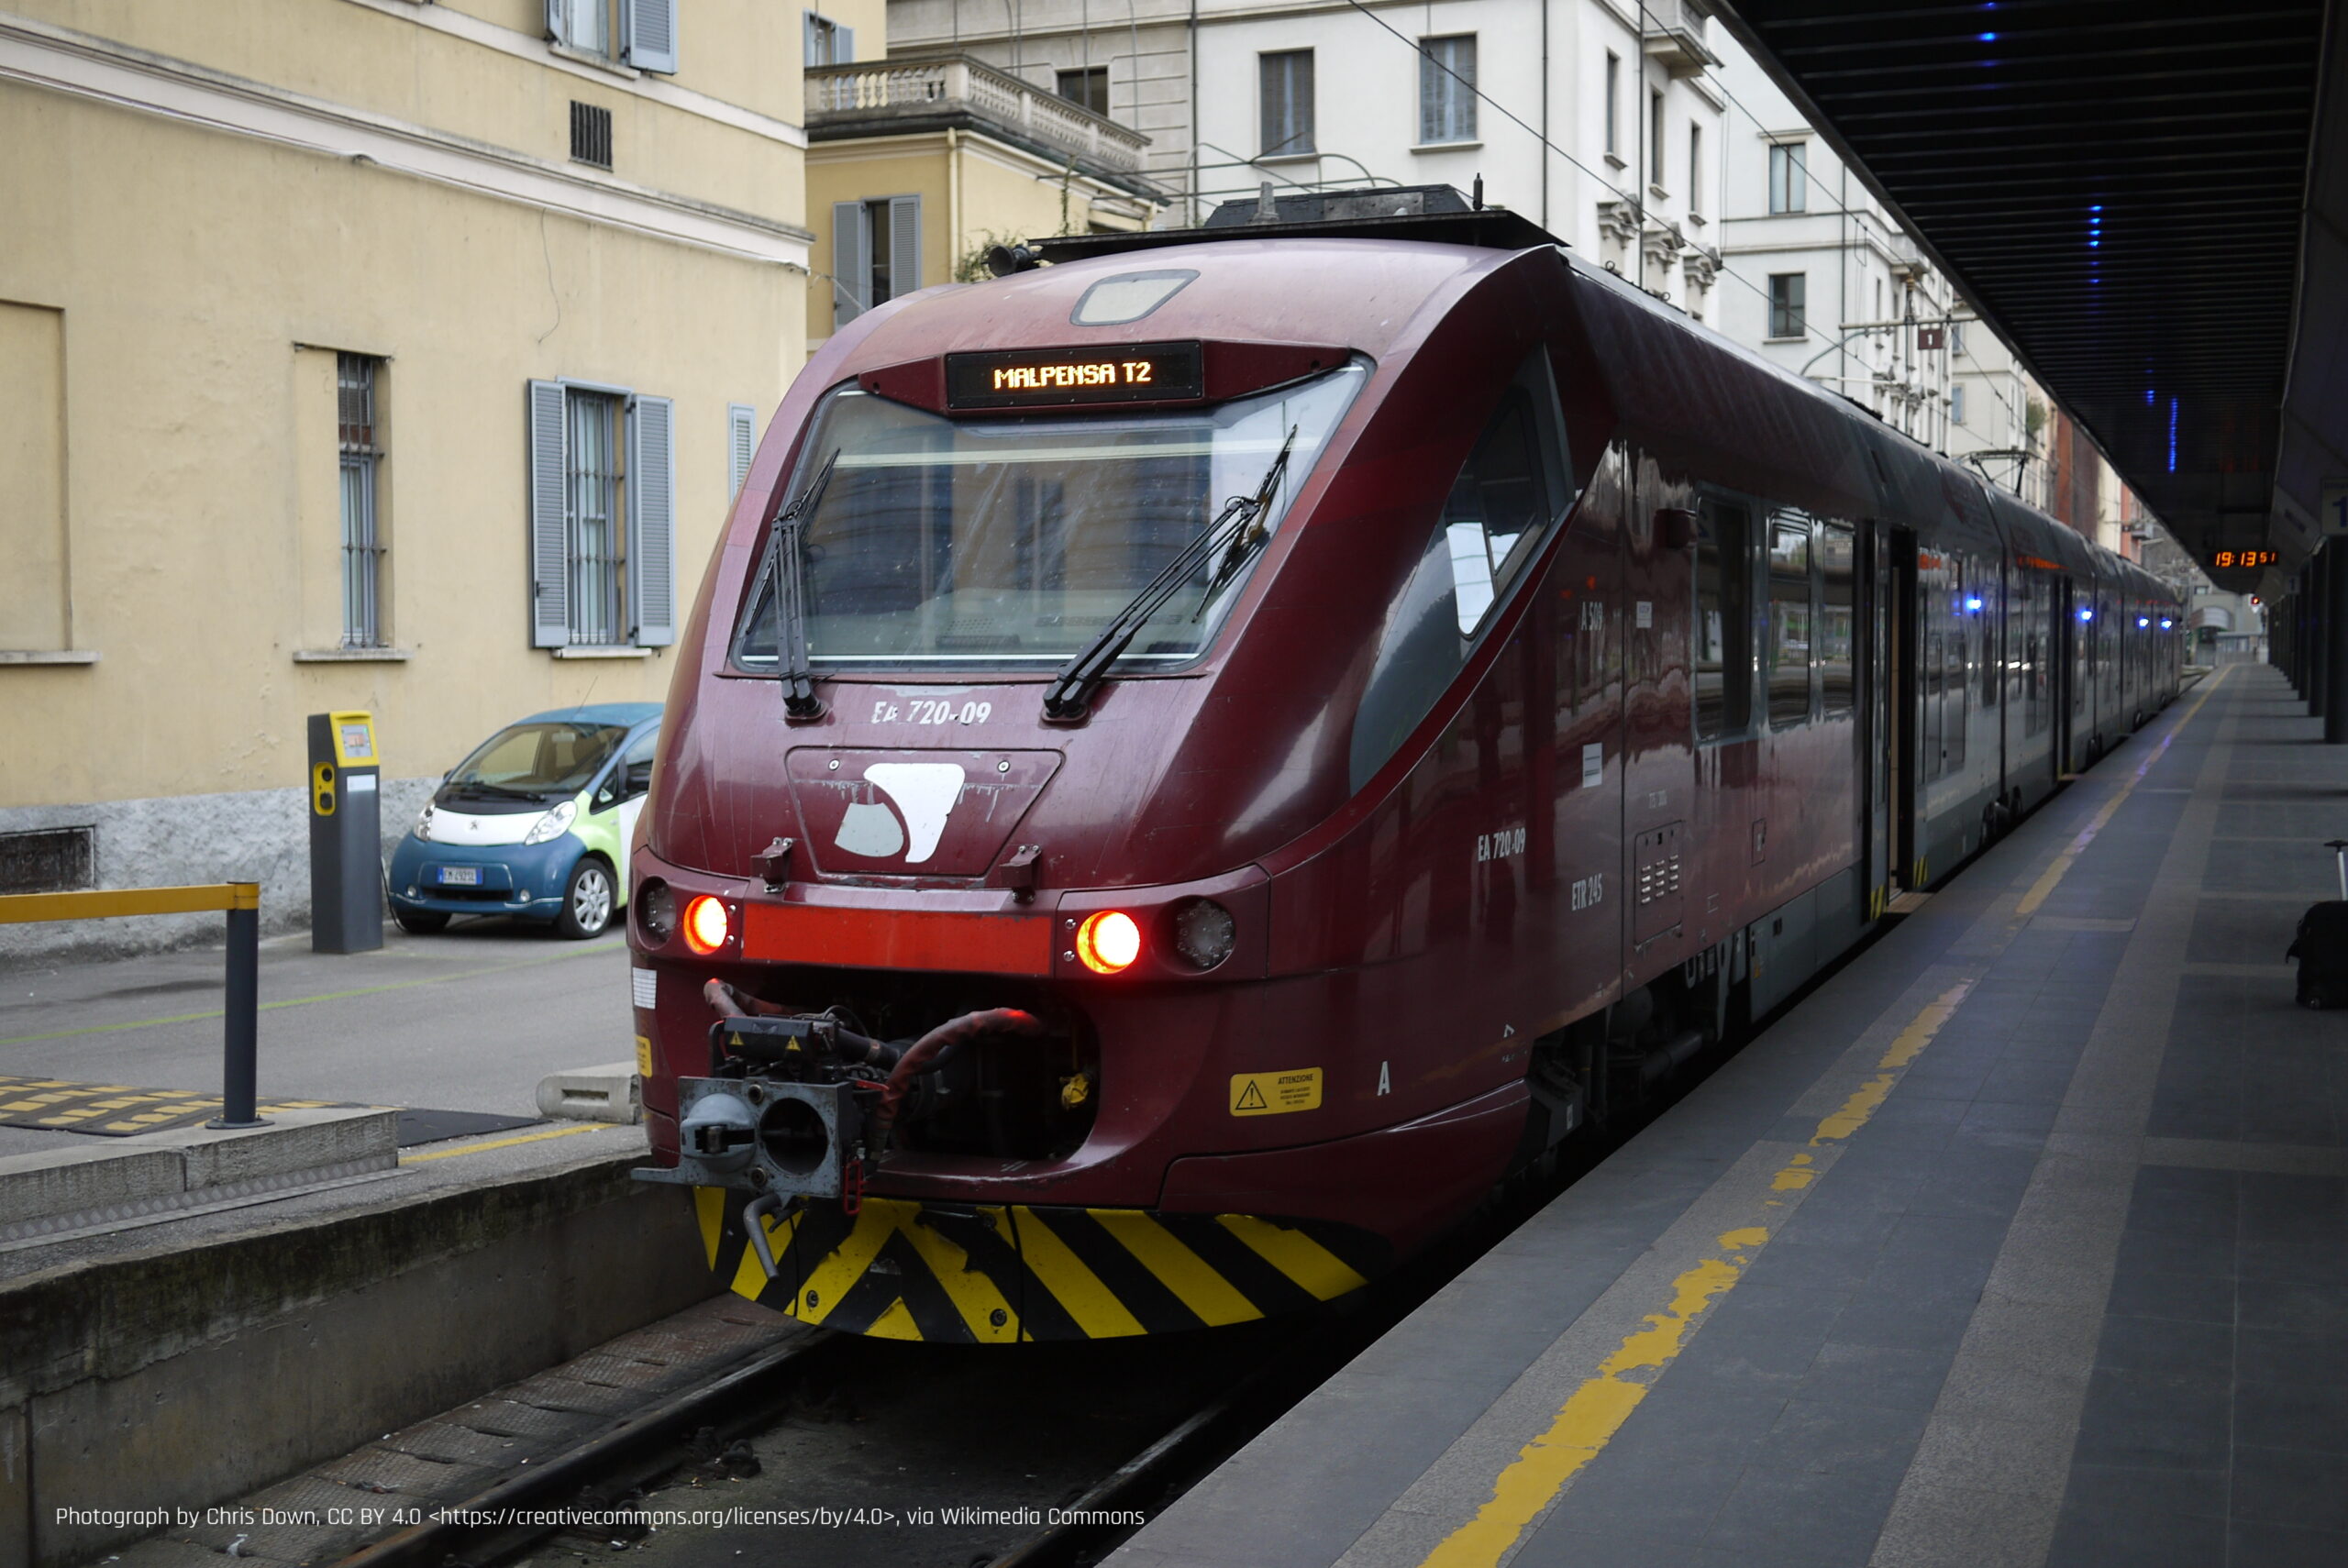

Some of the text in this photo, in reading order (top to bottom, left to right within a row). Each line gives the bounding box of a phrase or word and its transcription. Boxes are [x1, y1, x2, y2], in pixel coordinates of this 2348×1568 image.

[1927, 333, 1933, 346] 1
[993, 361, 1152, 389] MALPENSA T2
[906, 700, 992, 725] 720-09
[1478, 827, 1526, 862] EA 720-09
[1571, 872, 1602, 911] ETR 245
[1378, 1060, 1390, 1096] A
